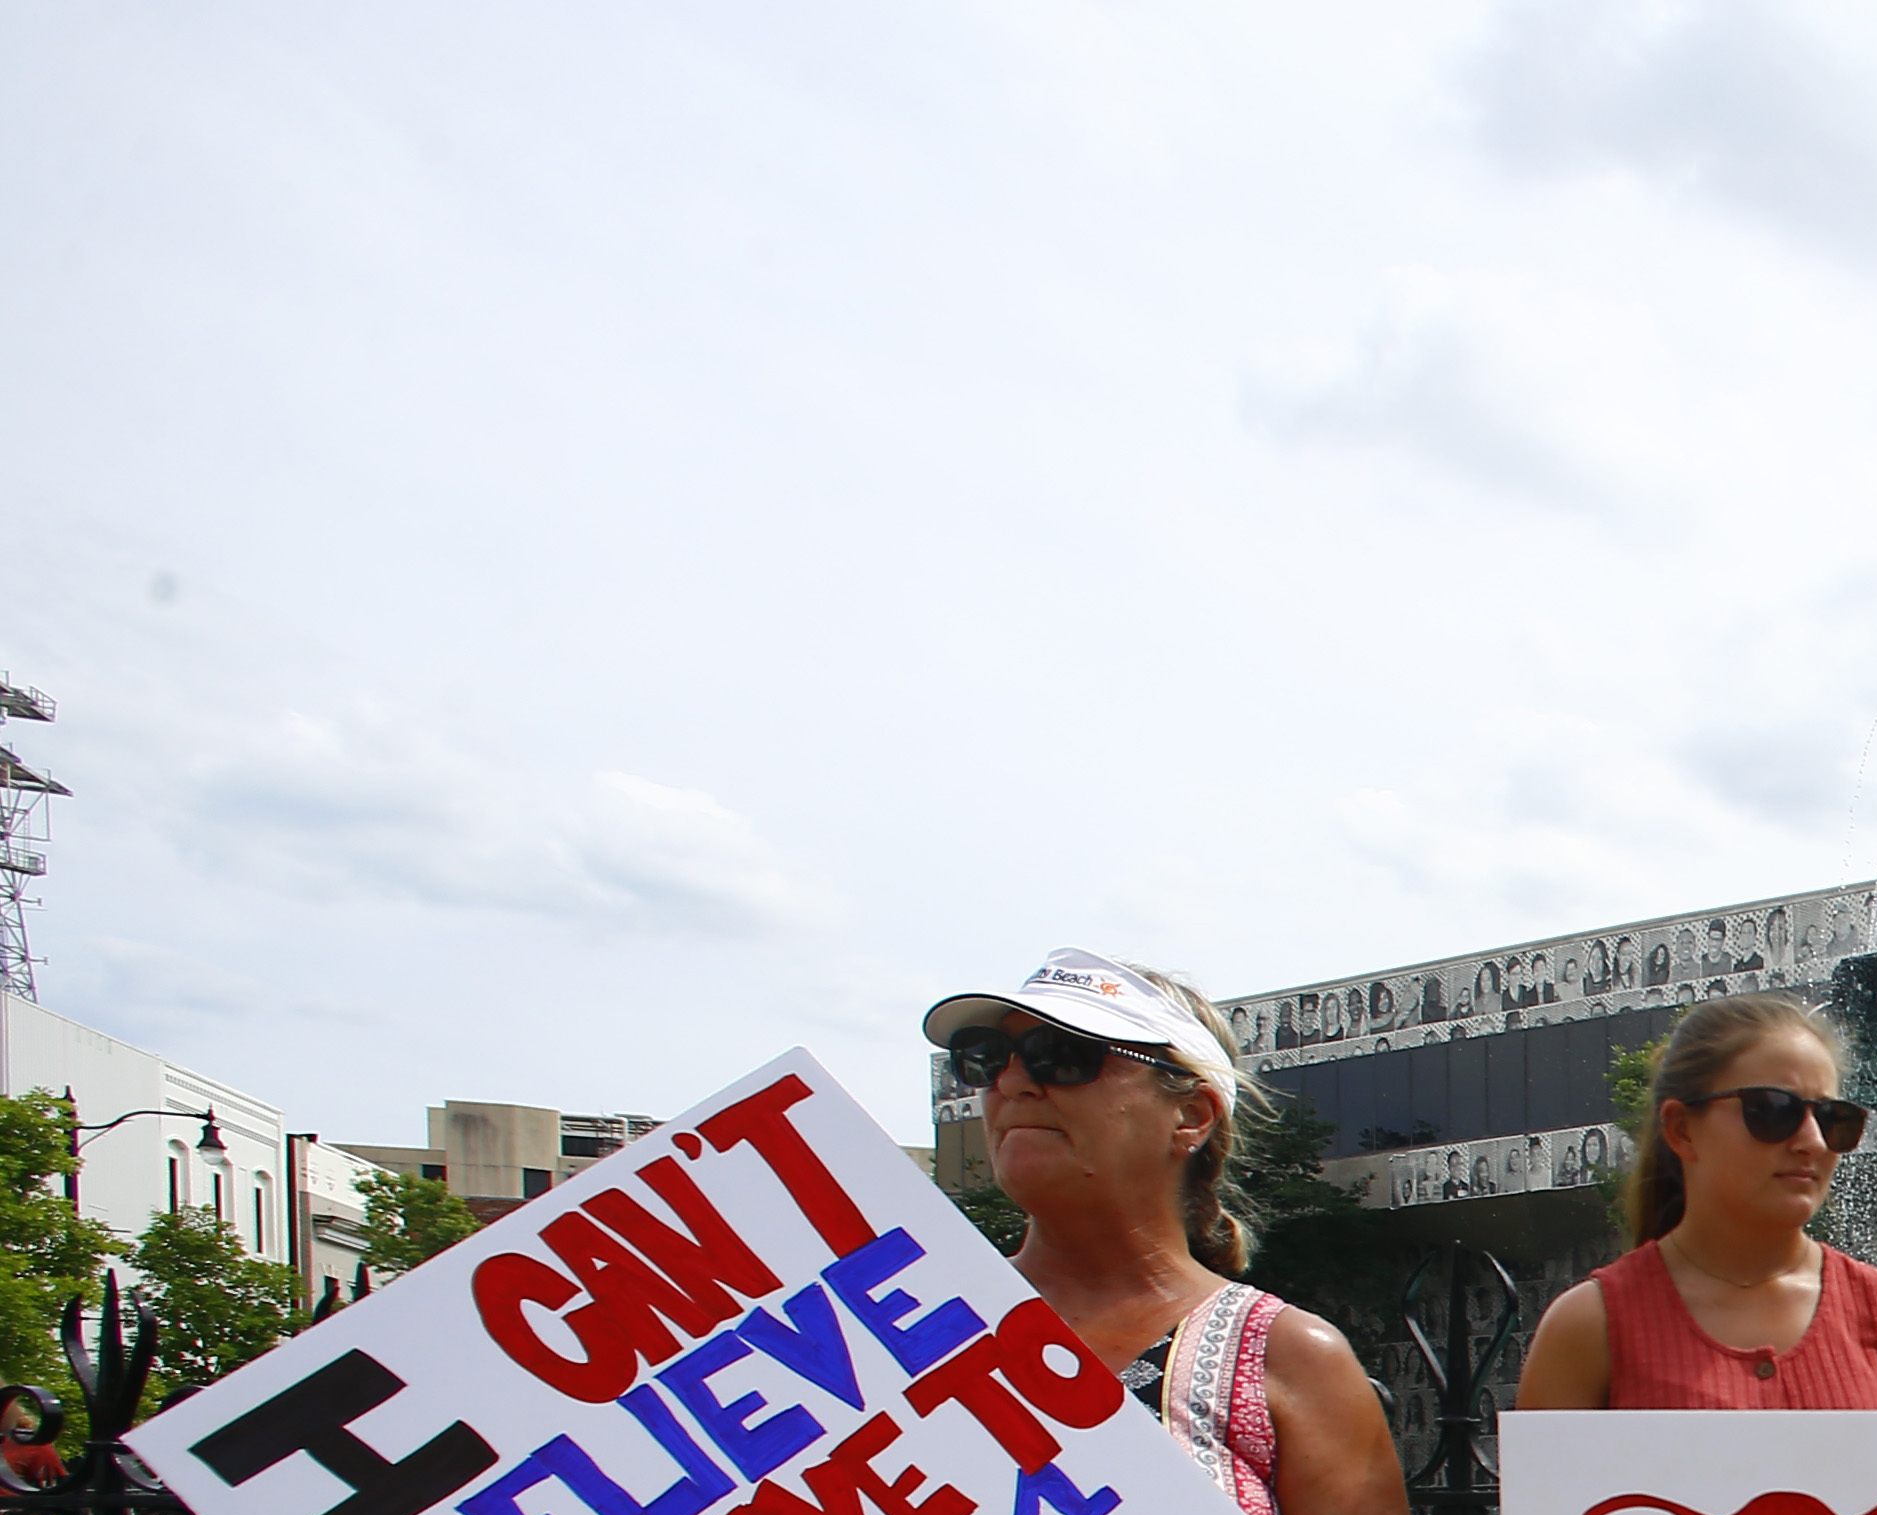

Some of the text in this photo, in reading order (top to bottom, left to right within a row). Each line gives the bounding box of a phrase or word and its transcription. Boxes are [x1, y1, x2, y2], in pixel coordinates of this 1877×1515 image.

[1052, 968, 1093, 987] Beach
[470, 1073, 879, 1403] CAN'T
[904, 1296, 1126, 1476] TO
